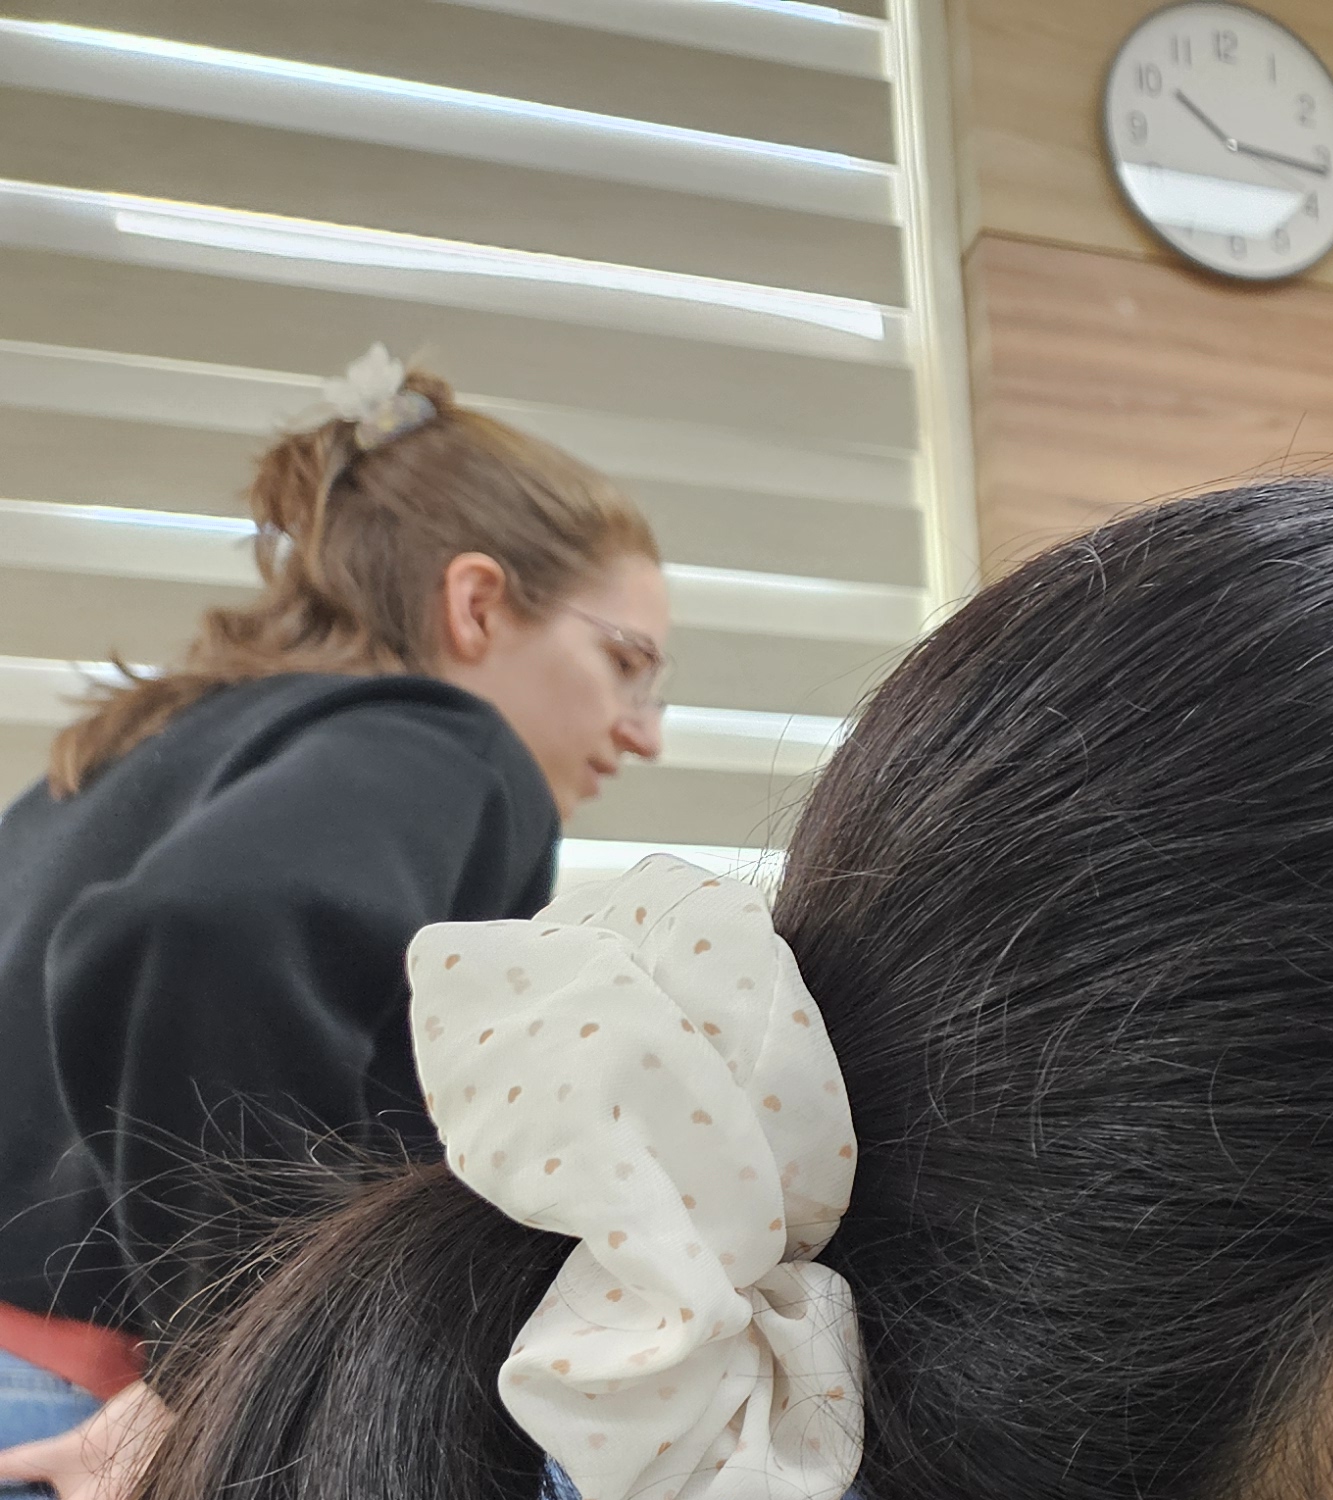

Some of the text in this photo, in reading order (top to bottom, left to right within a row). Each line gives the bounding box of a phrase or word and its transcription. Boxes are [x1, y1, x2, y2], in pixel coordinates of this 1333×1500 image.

[1172, 33, 1192, 67] 11
[1213, 28, 1239, 65] 12
[1137, 62, 1163, 99] 10
[1267, 51, 1277, 86] 1
[1126, 109, 1149, 147] 9
[1297, 93, 1317, 129] 2
[1303, 189, 1320, 223] 4
